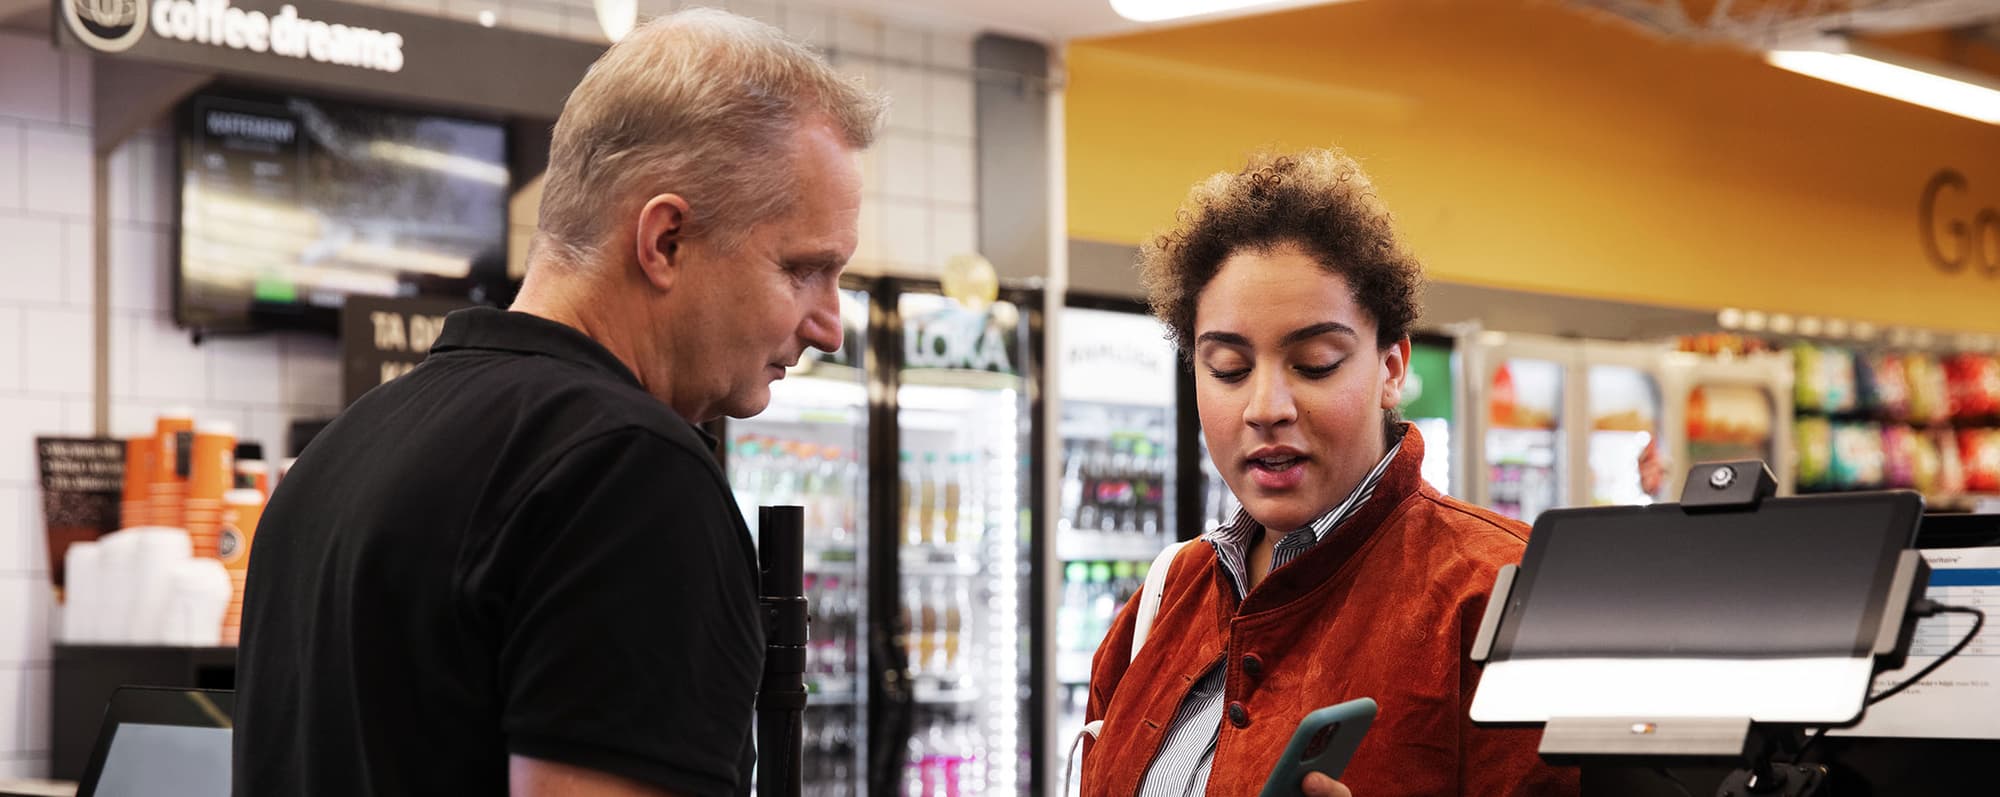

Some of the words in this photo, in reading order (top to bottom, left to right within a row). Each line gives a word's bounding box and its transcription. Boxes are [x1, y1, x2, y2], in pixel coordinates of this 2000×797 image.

[152, 0, 270, 52] coffee
[269, 4, 404, 72] dreams
[904, 312, 1013, 371] LOKA
